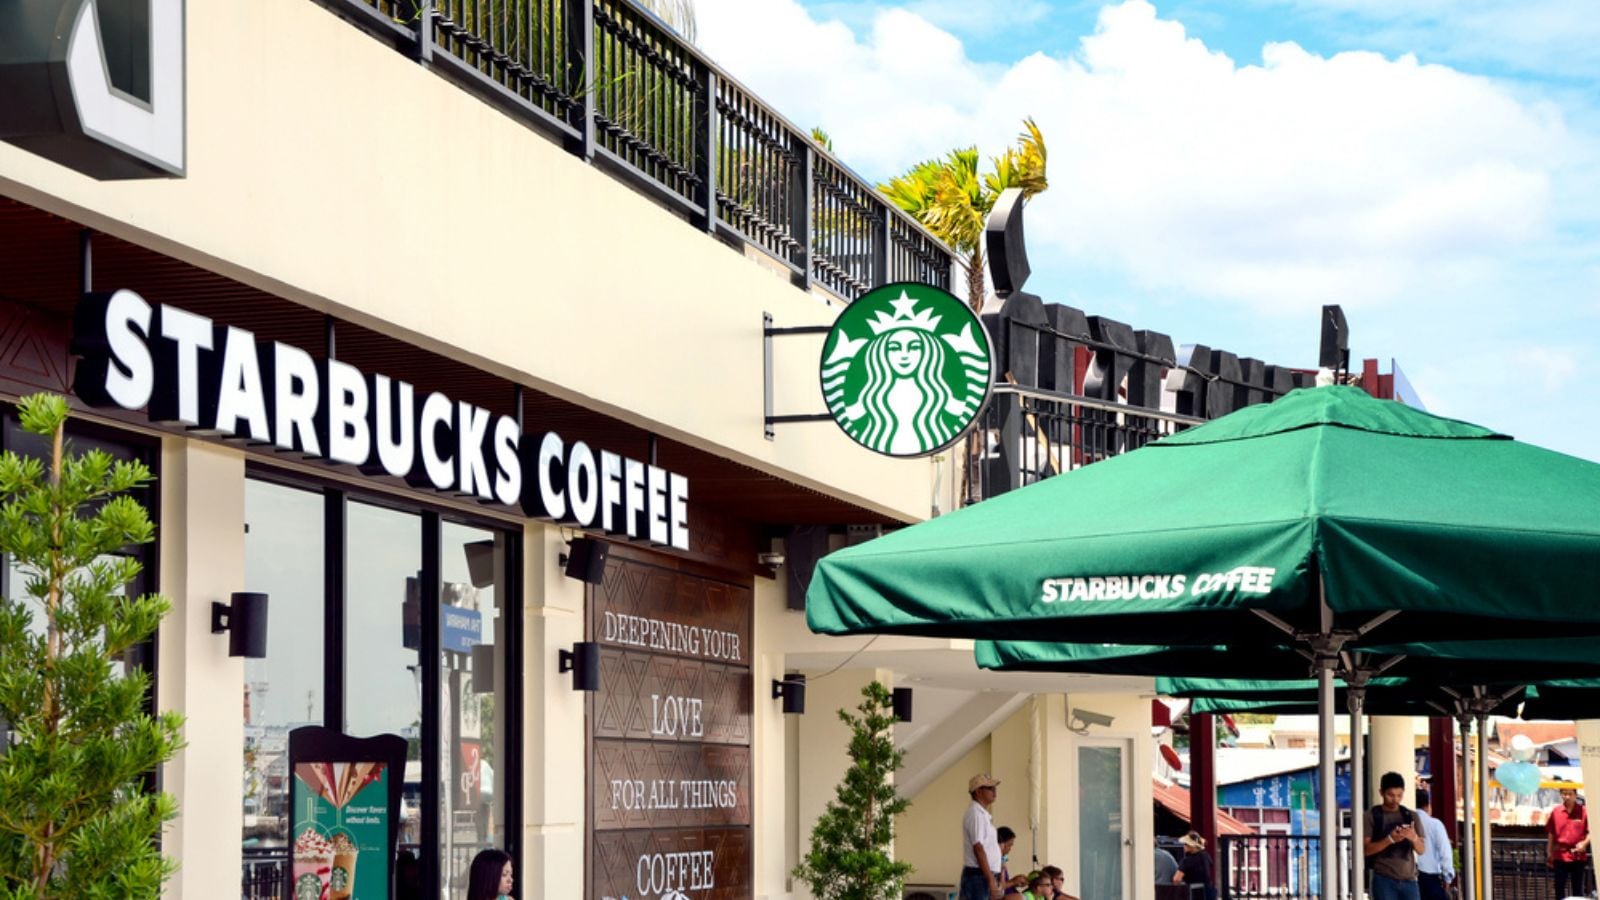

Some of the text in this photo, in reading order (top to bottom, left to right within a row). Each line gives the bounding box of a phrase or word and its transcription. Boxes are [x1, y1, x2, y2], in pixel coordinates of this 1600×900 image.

[104, 288, 690, 550] STARBUCKS COFFEE
[1041, 574, 1186, 603] STARBUCKS
[604, 611, 741, 661] DEEPENING YOUR
[651, 694, 704, 737] LOVE
[611, 779, 737, 810] FOR ALL THINGS
[636, 851, 715, 896] COFFEE
